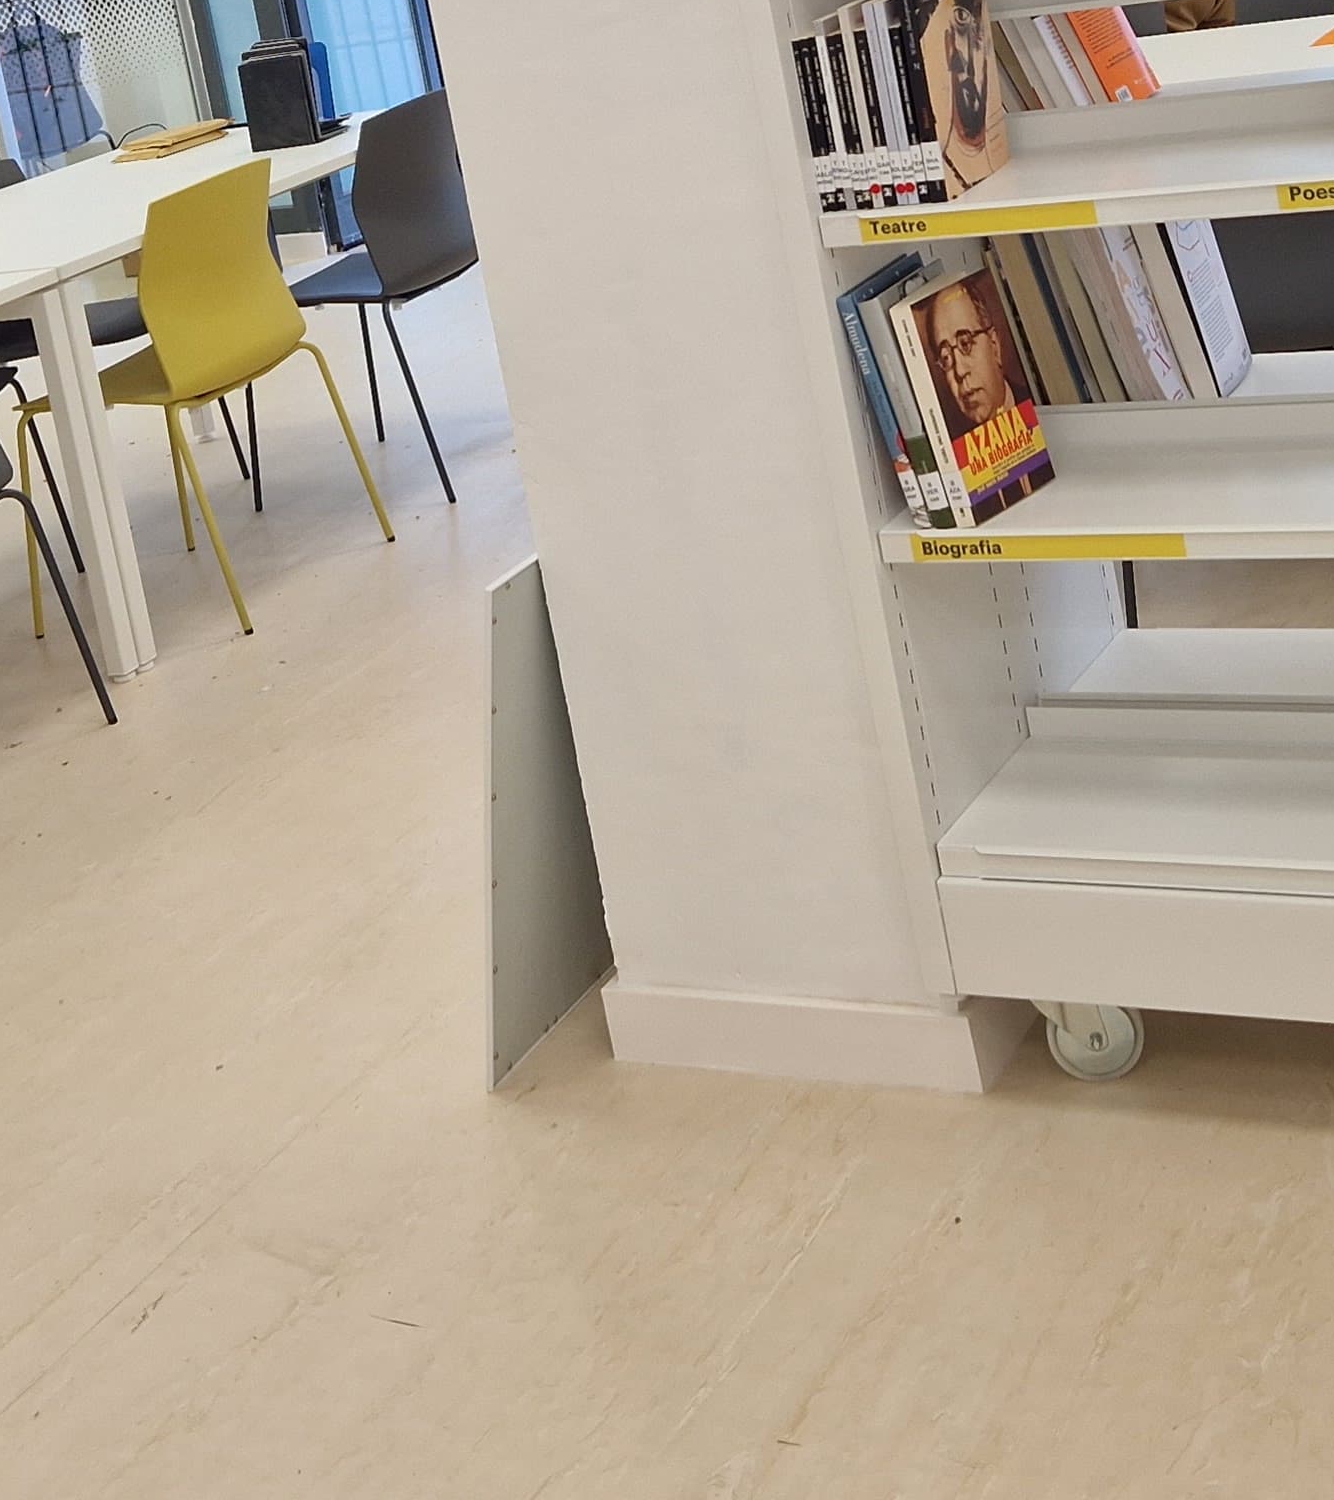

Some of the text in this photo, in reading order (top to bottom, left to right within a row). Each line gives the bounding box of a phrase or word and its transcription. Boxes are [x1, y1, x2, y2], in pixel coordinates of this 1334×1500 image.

[869, 219, 927, 236] Teatre
[842, 312, 871, 376] Almudena
[969, 456, 989, 476] UNA
[921, 539, 1002, 559] Biografia
